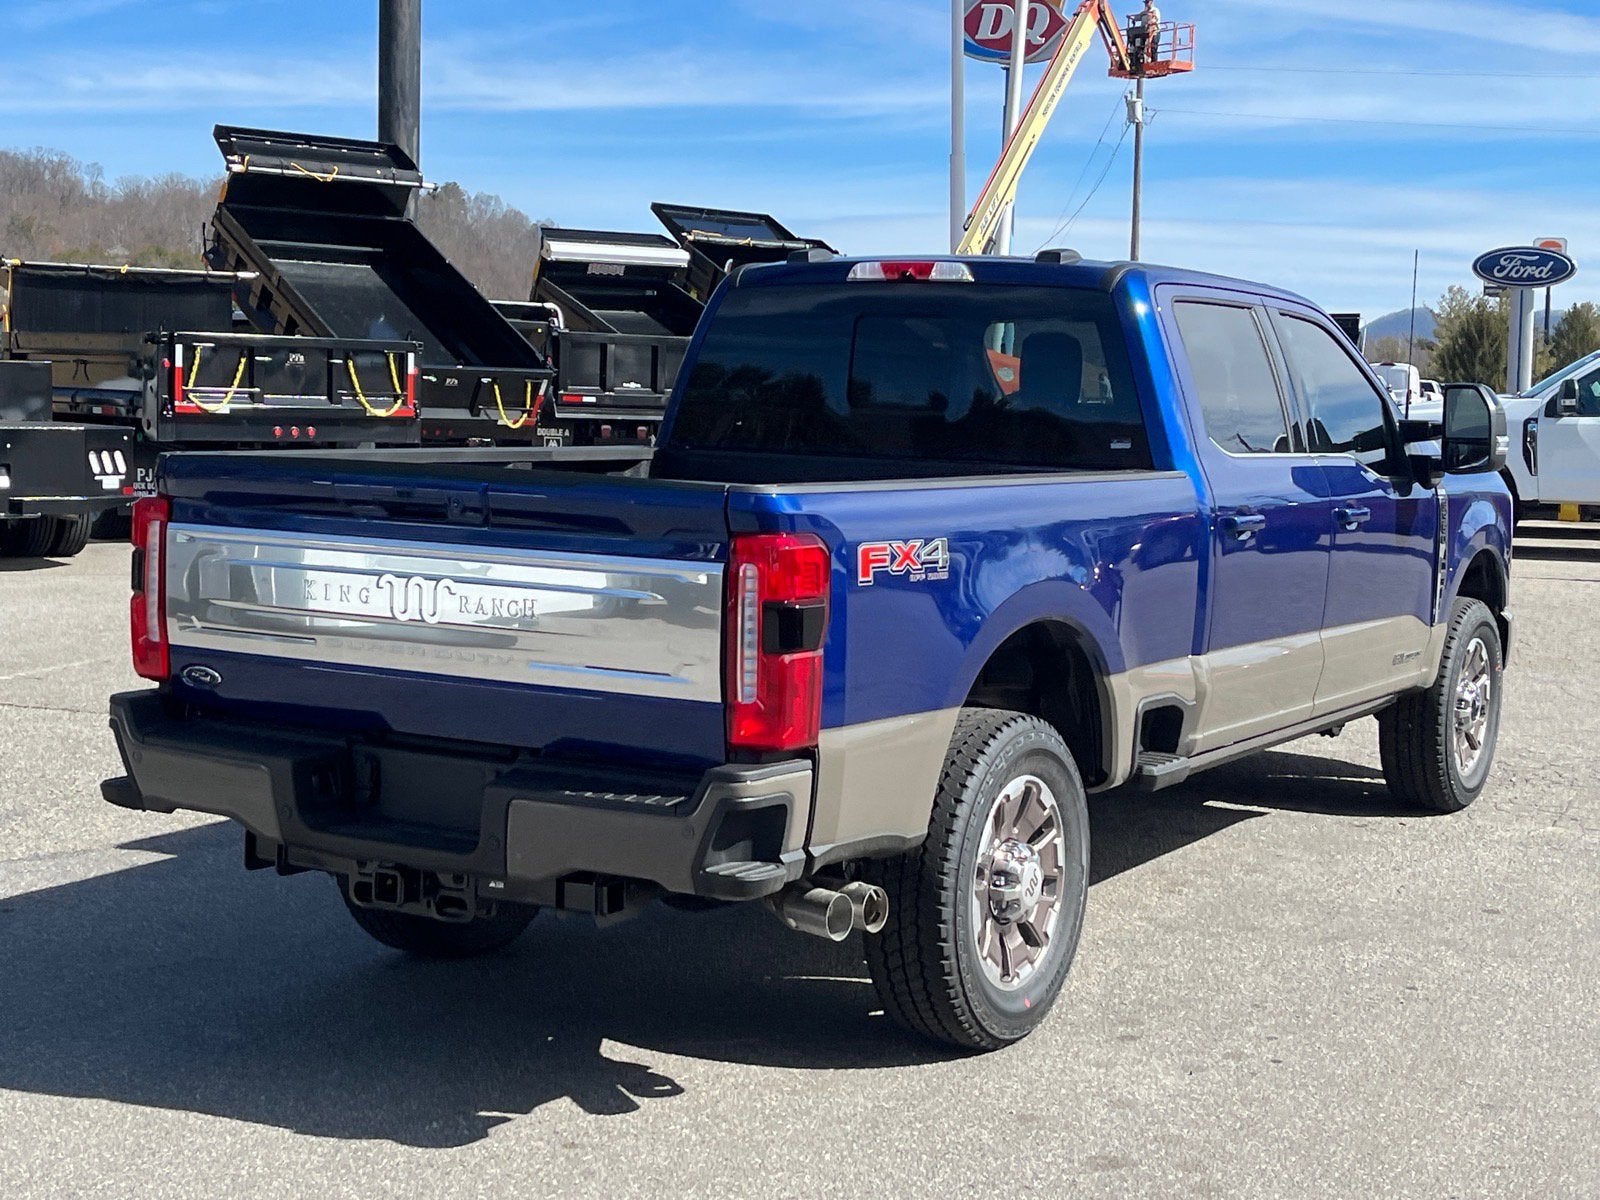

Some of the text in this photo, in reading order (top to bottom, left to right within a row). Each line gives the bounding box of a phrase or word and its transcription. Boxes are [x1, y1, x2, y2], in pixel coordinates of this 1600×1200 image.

[975, 3, 1046, 45] DQ
[1493, 254, 1554, 278] Ford
[137, 468, 153, 481] PJ
[857, 538, 949, 586] FX4
[303, 578, 538, 620] KING RANCH
